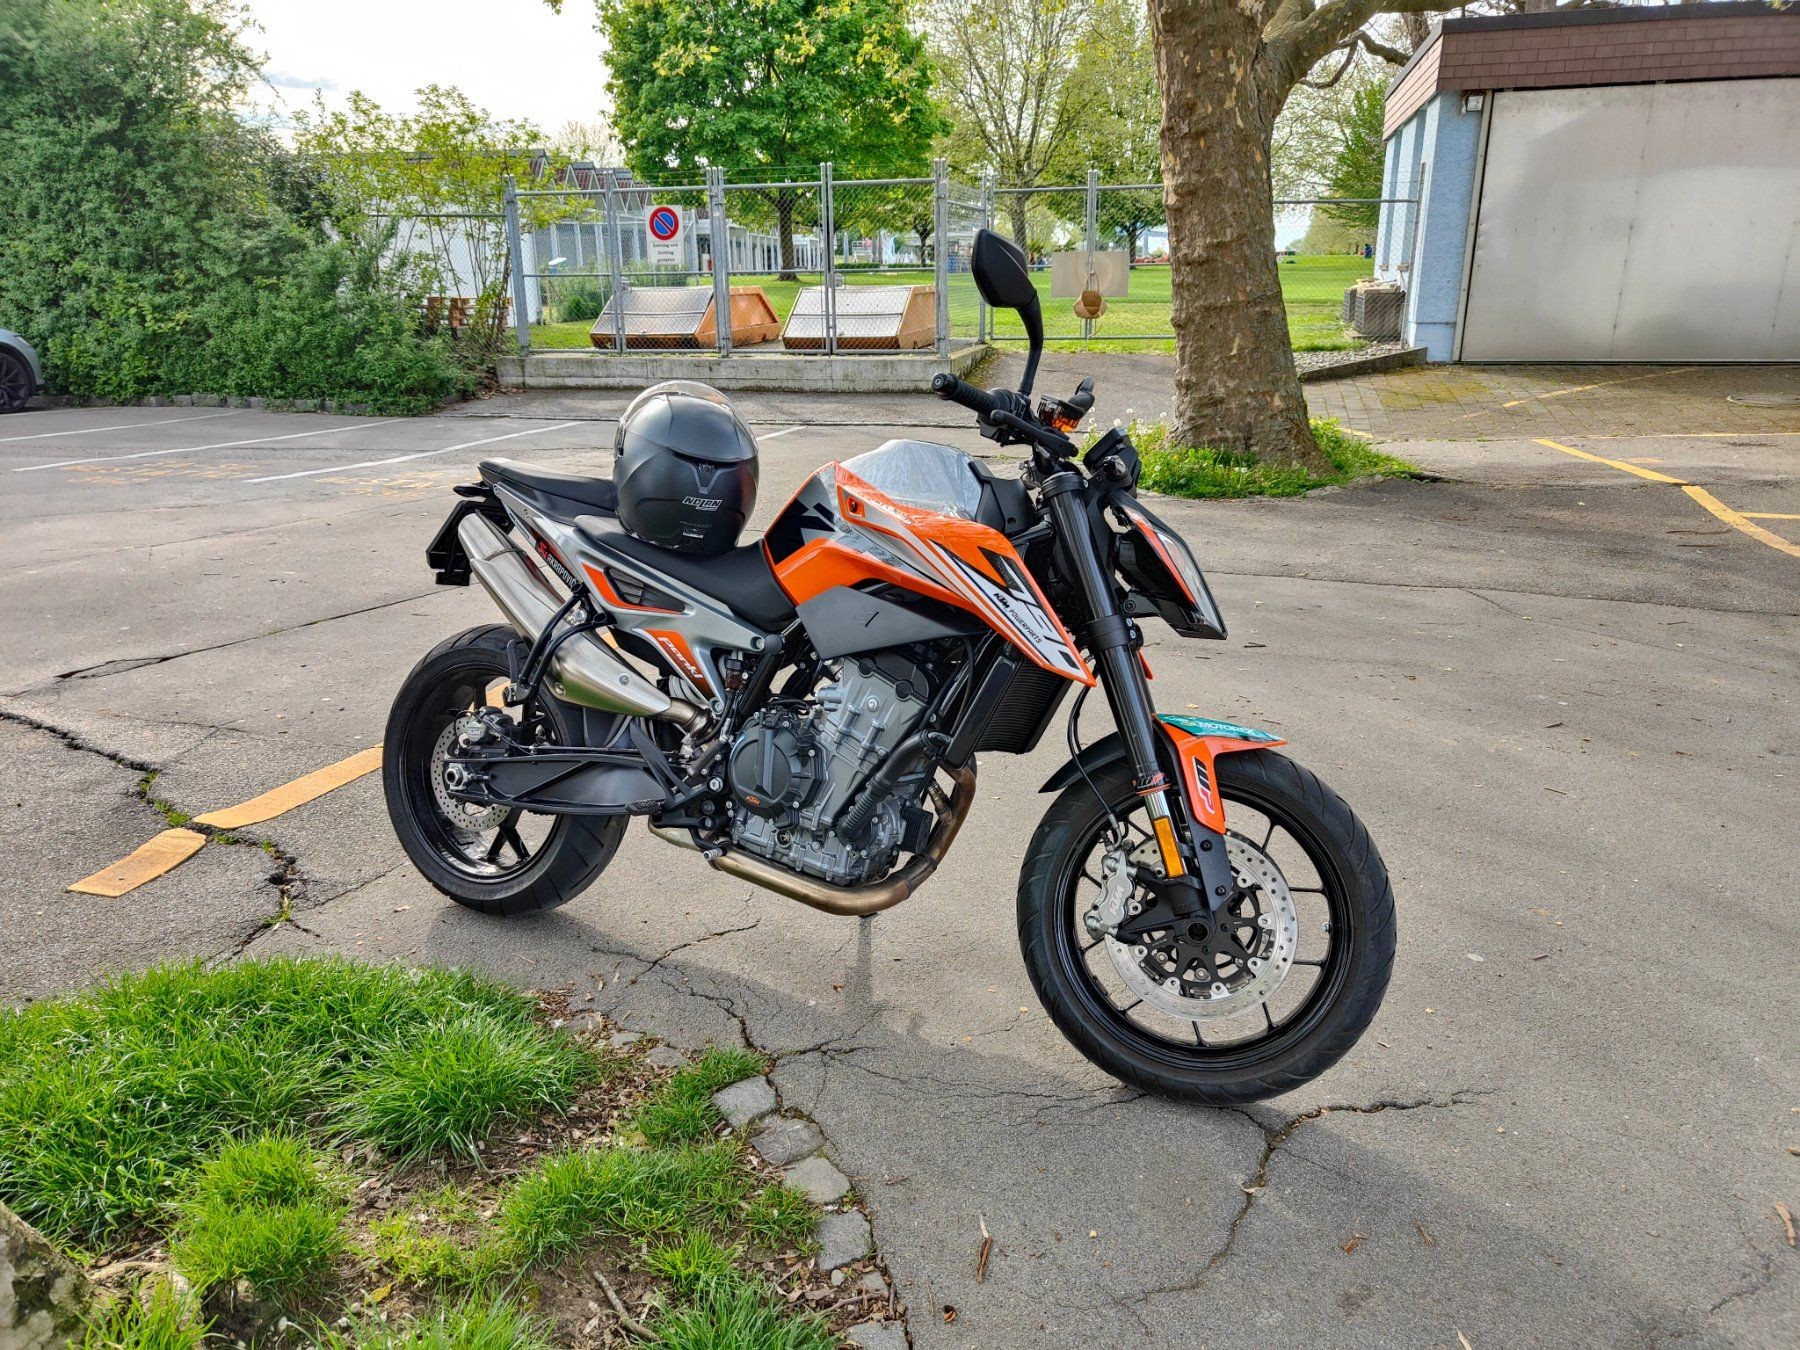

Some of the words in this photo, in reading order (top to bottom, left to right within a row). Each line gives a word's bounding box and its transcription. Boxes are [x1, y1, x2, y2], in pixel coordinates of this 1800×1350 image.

[682, 496, 722, 509] NOLAN
[993, 593, 1010, 609] KTM
[1009, 609, 1042, 644] POWERPARTS
[745, 795, 761, 806] KTM
[1108, 885, 1125, 916] KTM
